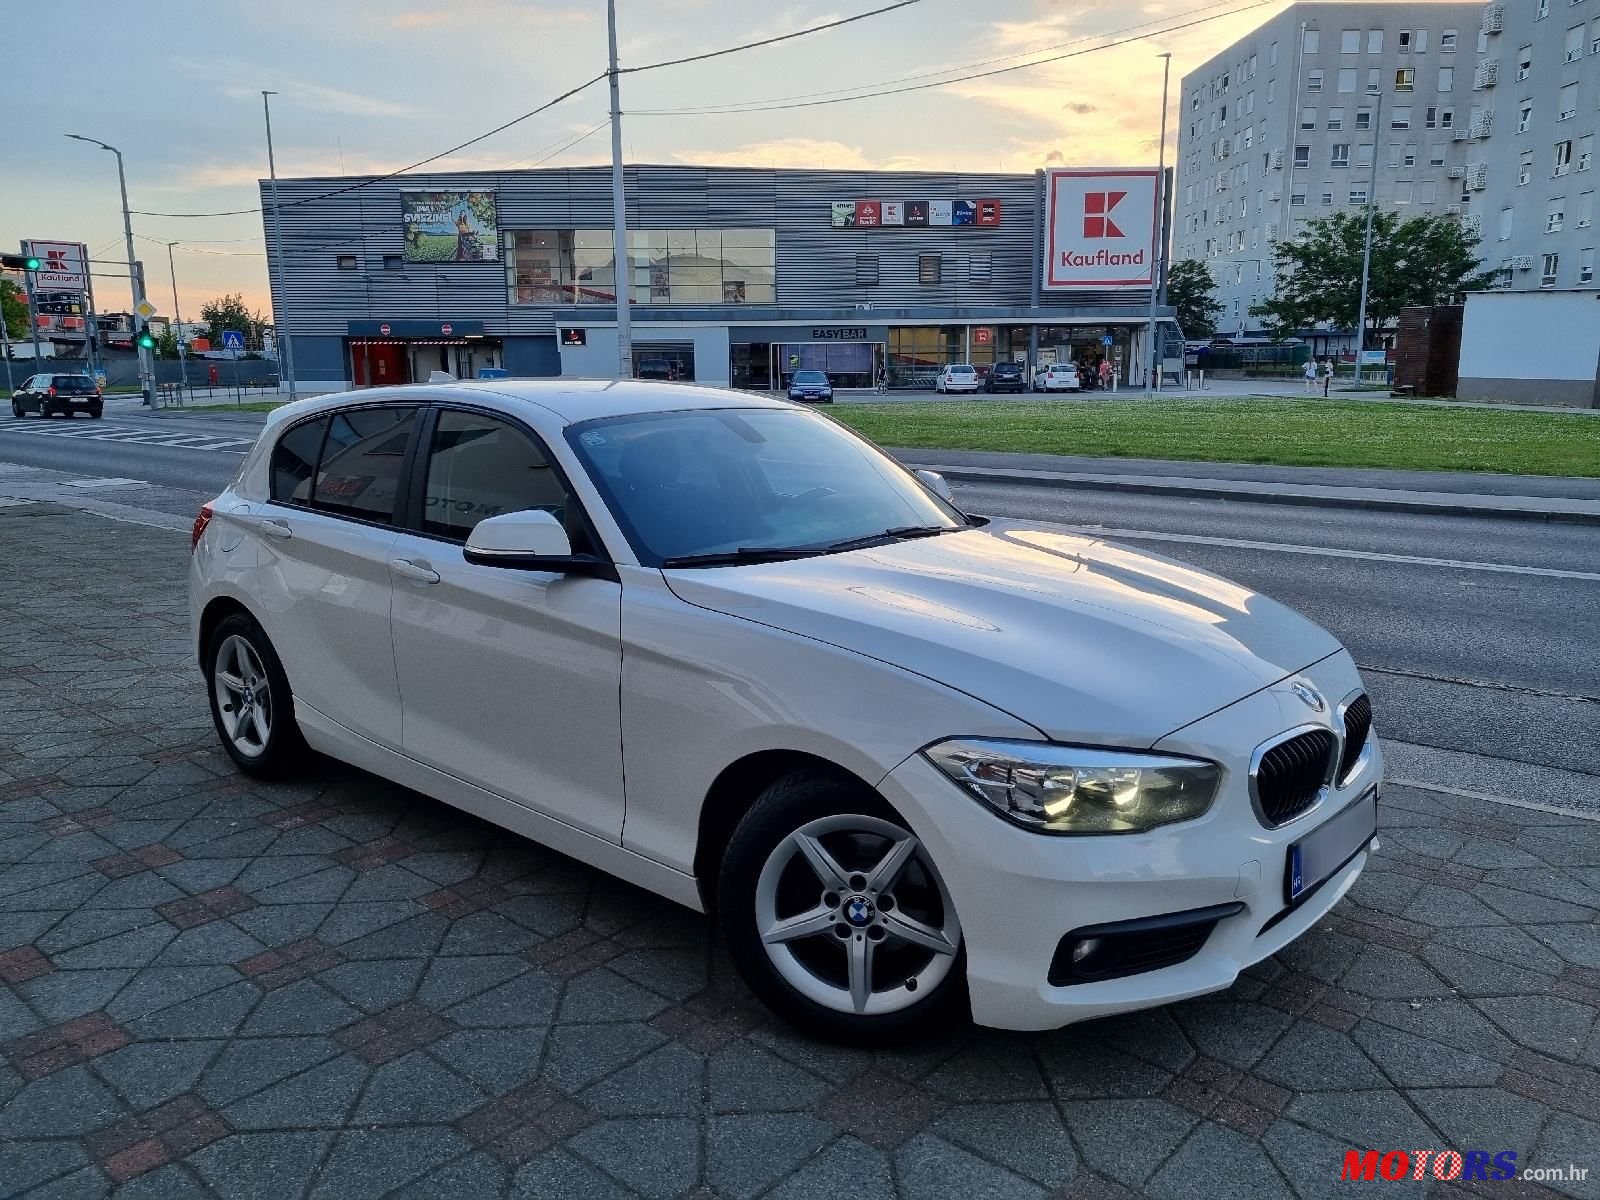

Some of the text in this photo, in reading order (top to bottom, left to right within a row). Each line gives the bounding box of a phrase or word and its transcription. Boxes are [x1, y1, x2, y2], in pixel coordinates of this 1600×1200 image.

[1061, 248, 1144, 267] Kaufland
[812, 329, 867, 339] EASY BAR
